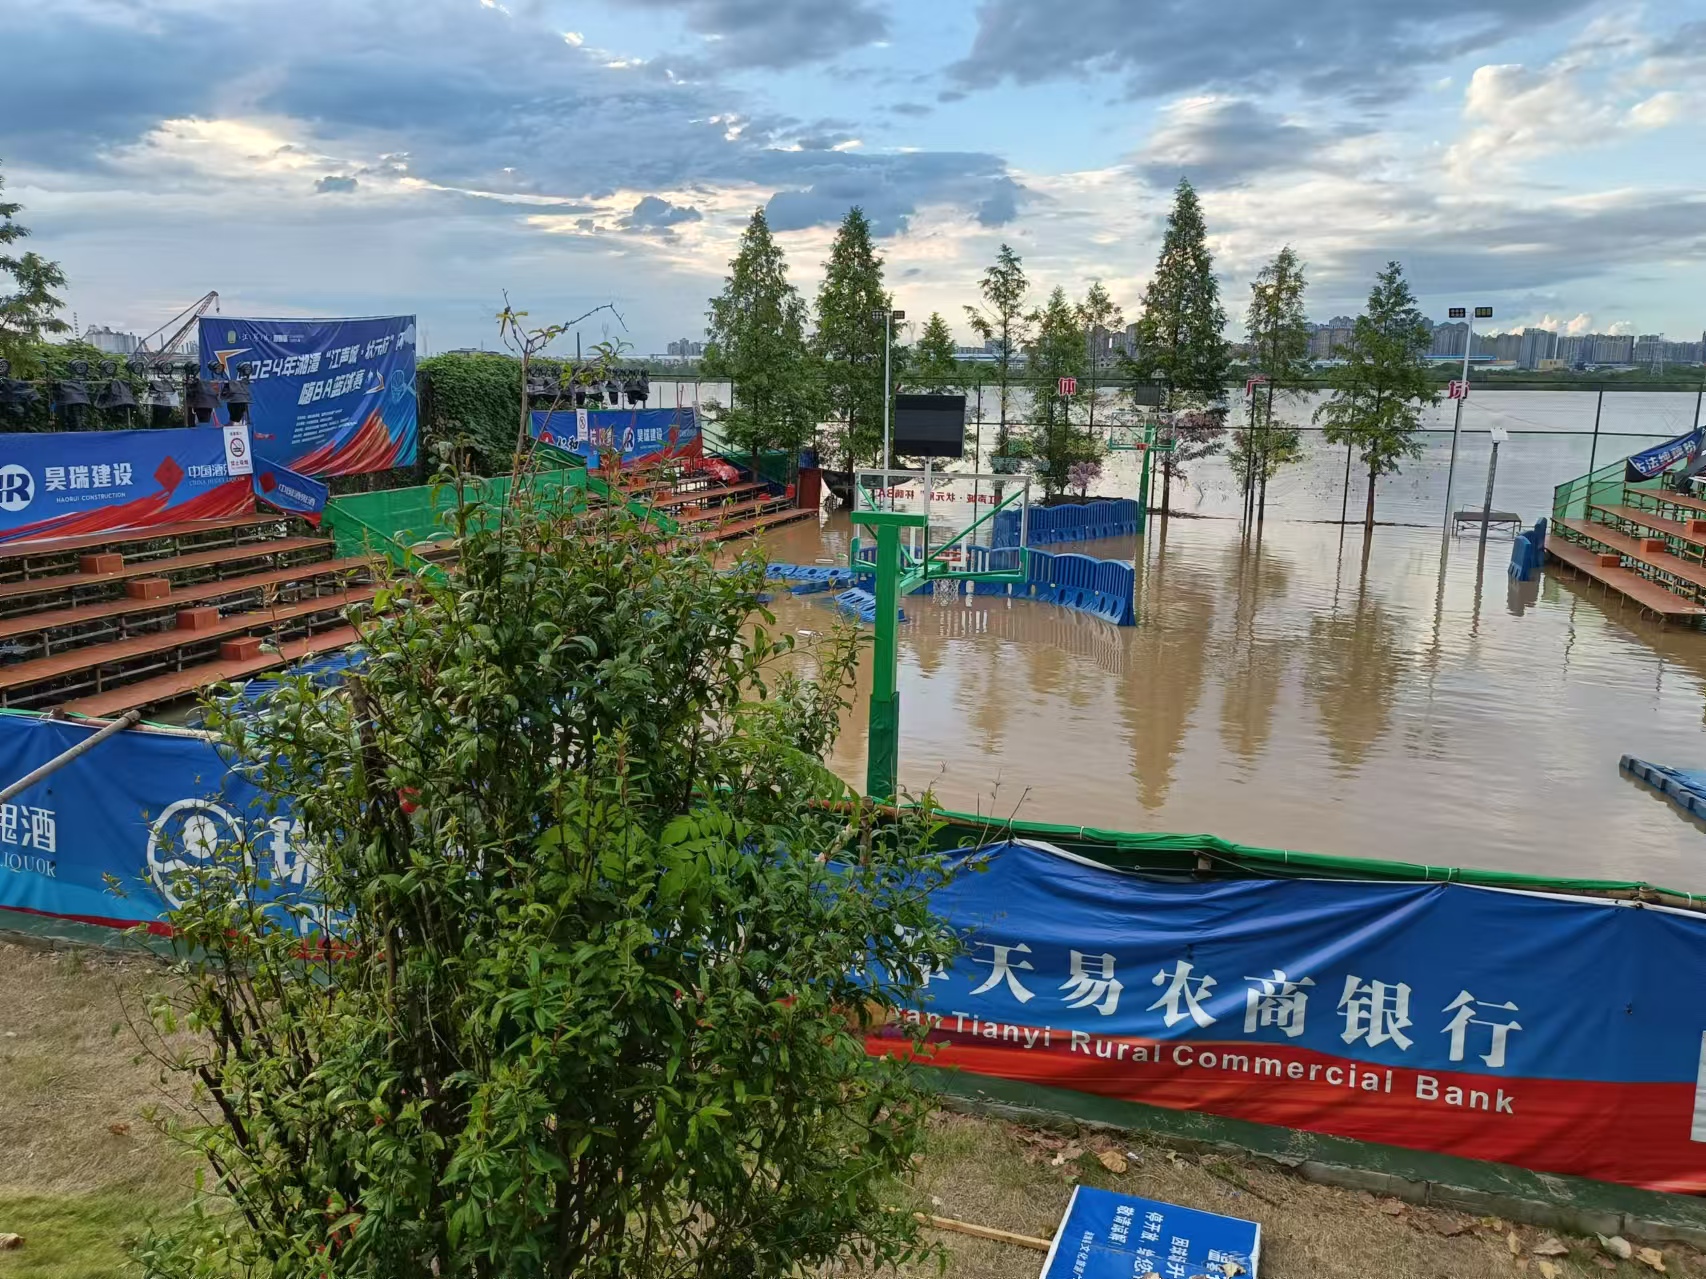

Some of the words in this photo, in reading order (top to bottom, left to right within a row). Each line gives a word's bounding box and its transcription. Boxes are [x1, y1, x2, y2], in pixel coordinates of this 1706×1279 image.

[1058, 377, 1077, 396] 体
[44, 462, 134, 492] 昊瑞建设
[56, 496, 80, 504] HAORUI
[81, 492, 126, 501] CONSTRUCTION
[0, 852, 56, 878] IQUOR
[952, 1011, 1051, 1048] Tianyi
[1071, 1029, 1162, 1064] Rural
[1172, 1044, 1393, 1093] Commercial
[1416, 1074, 1516, 1115] Bank
